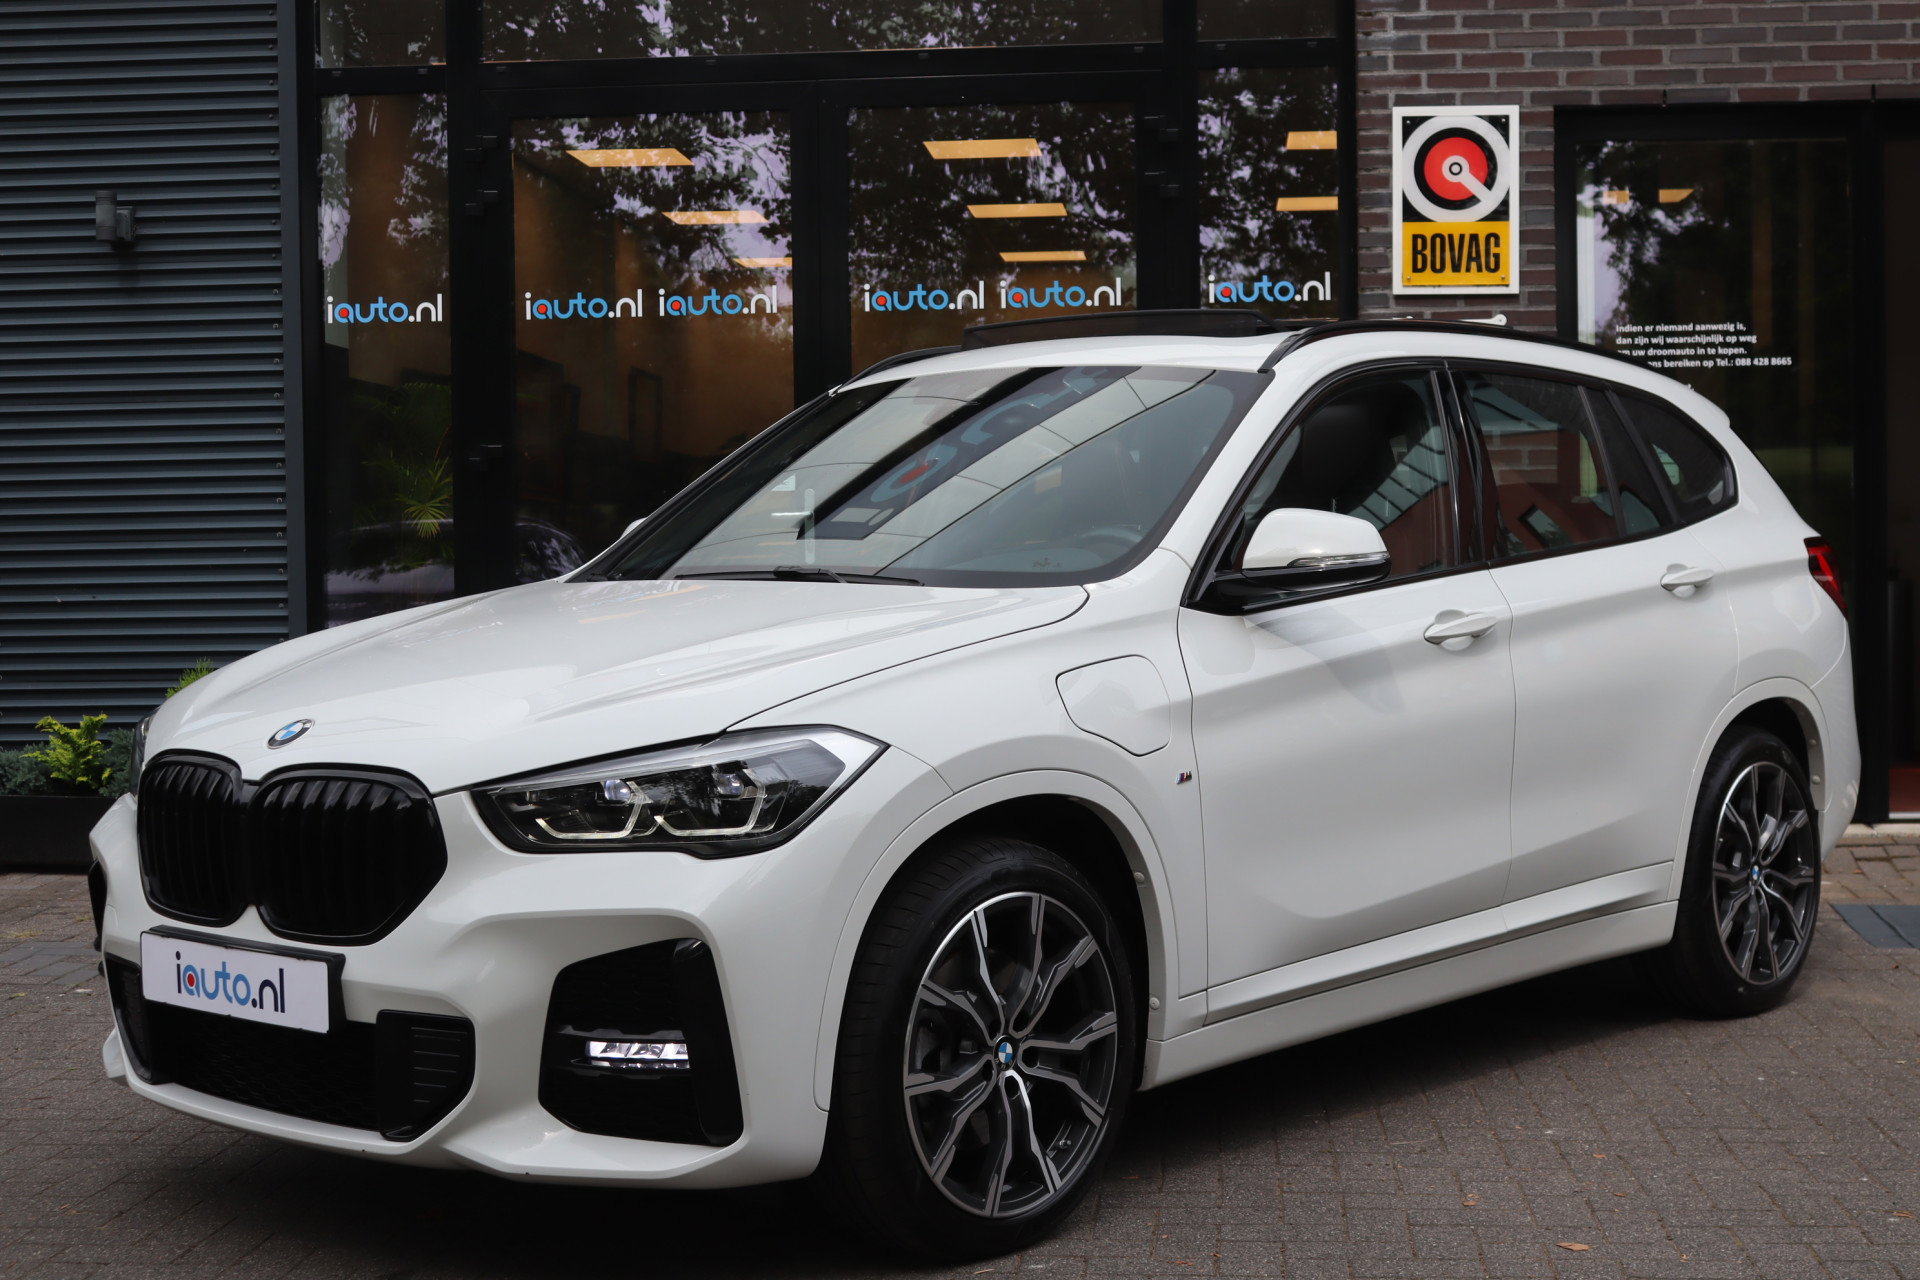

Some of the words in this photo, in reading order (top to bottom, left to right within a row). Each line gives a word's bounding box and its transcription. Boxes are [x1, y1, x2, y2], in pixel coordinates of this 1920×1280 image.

[1412, 233, 1500, 274] BOVAG
[525, 288, 643, 320] iauto.nl
[659, 285, 778, 317] iauto.nl
[864, 280, 985, 312] iauto.nl
[1000, 277, 1122, 309] iauto.nl
[1209, 271, 1331, 303] iauto.nl
[326, 293, 443, 324] iauto.nl
[1616, 324, 1643, 333] Indien
[1655, 323, 1694, 332] niemand
[1695, 322, 1735, 332] aanwezig
[1736, 321, 1747, 332] is,
[1616, 336, 1633, 345] dan
[1634, 335, 1650, 346] zijn
[1650, 335, 1665, 346] wij
[1665, 334, 1724, 345] waarschijnlijk
[1725, 335, 1738, 344] op
[1738, 335, 1758, 344] weg
[1647, 346, 1696, 356] droomauto
[1696, 346, 1706, 355] in
[1706, 347, 1717, 355] te
[1717, 345, 1748, 356] kopen.
[1663, 358, 1702, 368] bereiken
[1702, 359, 1715, 369] op
[1715, 357, 1735, 367] Tel.:
[1735, 357, 1752, 367] 088
[1752, 357, 1770, 366] 428
[1770, 356, 1793, 366] 8665
[175, 950, 286, 1014] iauto.nl
